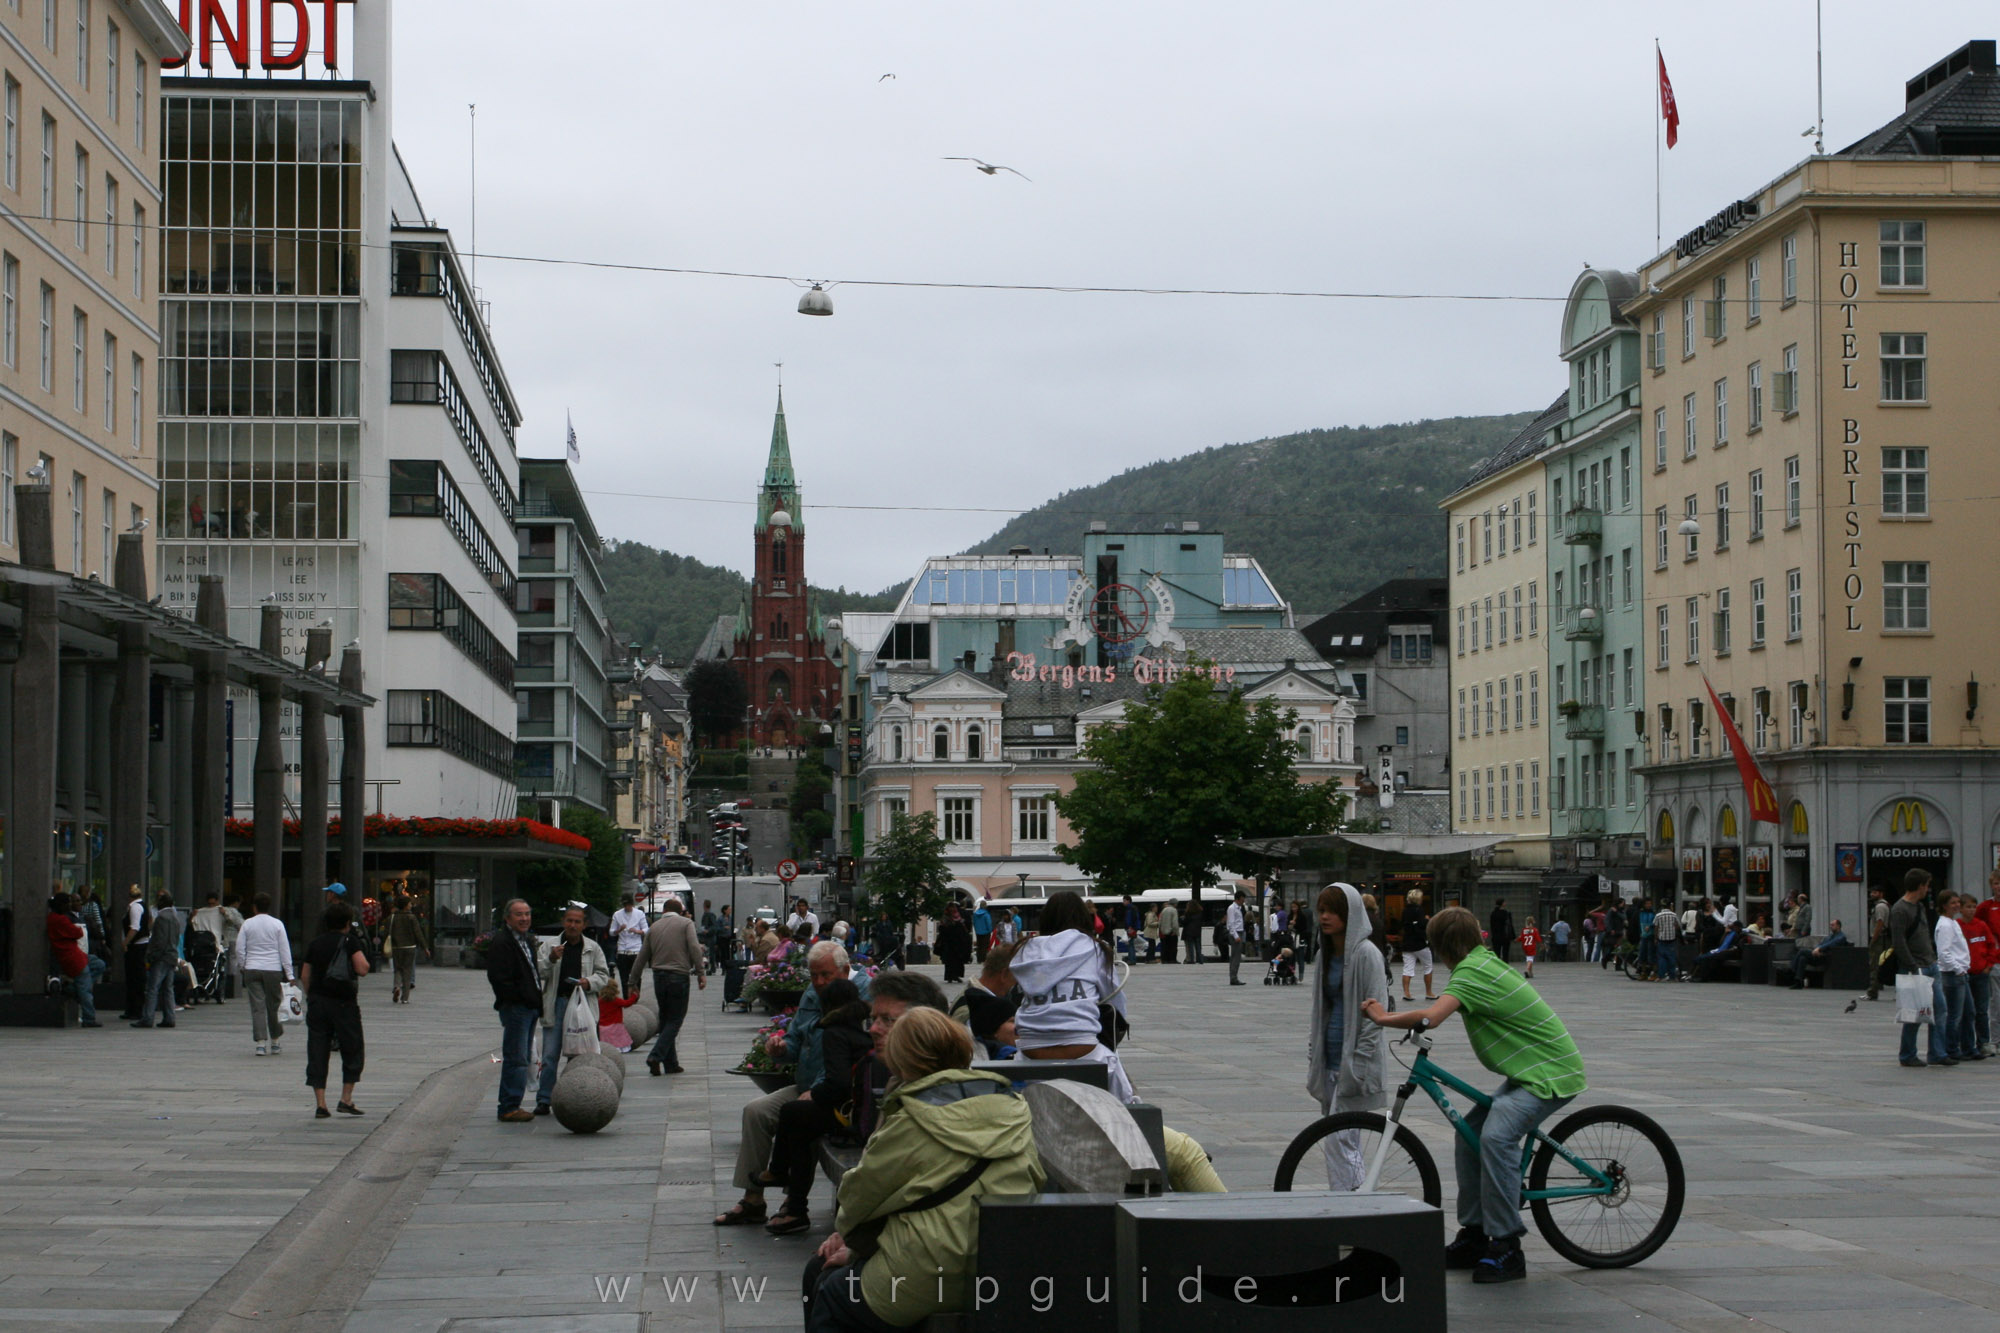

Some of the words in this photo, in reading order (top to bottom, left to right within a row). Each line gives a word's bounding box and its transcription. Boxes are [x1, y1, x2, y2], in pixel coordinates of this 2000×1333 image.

[1676, 226, 1704, 259] HOTEL
[1704, 200, 1744, 242] BRISTOL
[1839, 242, 1859, 390] HOTEL
[1843, 418, 1862, 632] BRISTOL
[177, 555, 207, 566] ACNE
[282, 557, 314, 567] LEVI'S
[290, 574, 307, 584] LEE
[1067, 584, 1083, 613] ANNO
[1155, 585, 1171, 612] 1868
[1007, 651, 1116, 689] Bergens
[1382, 758, 1391, 793] BAR
[1871, 847, 1950, 858] McDonald's
[1524, 935, 1533, 946] 22
